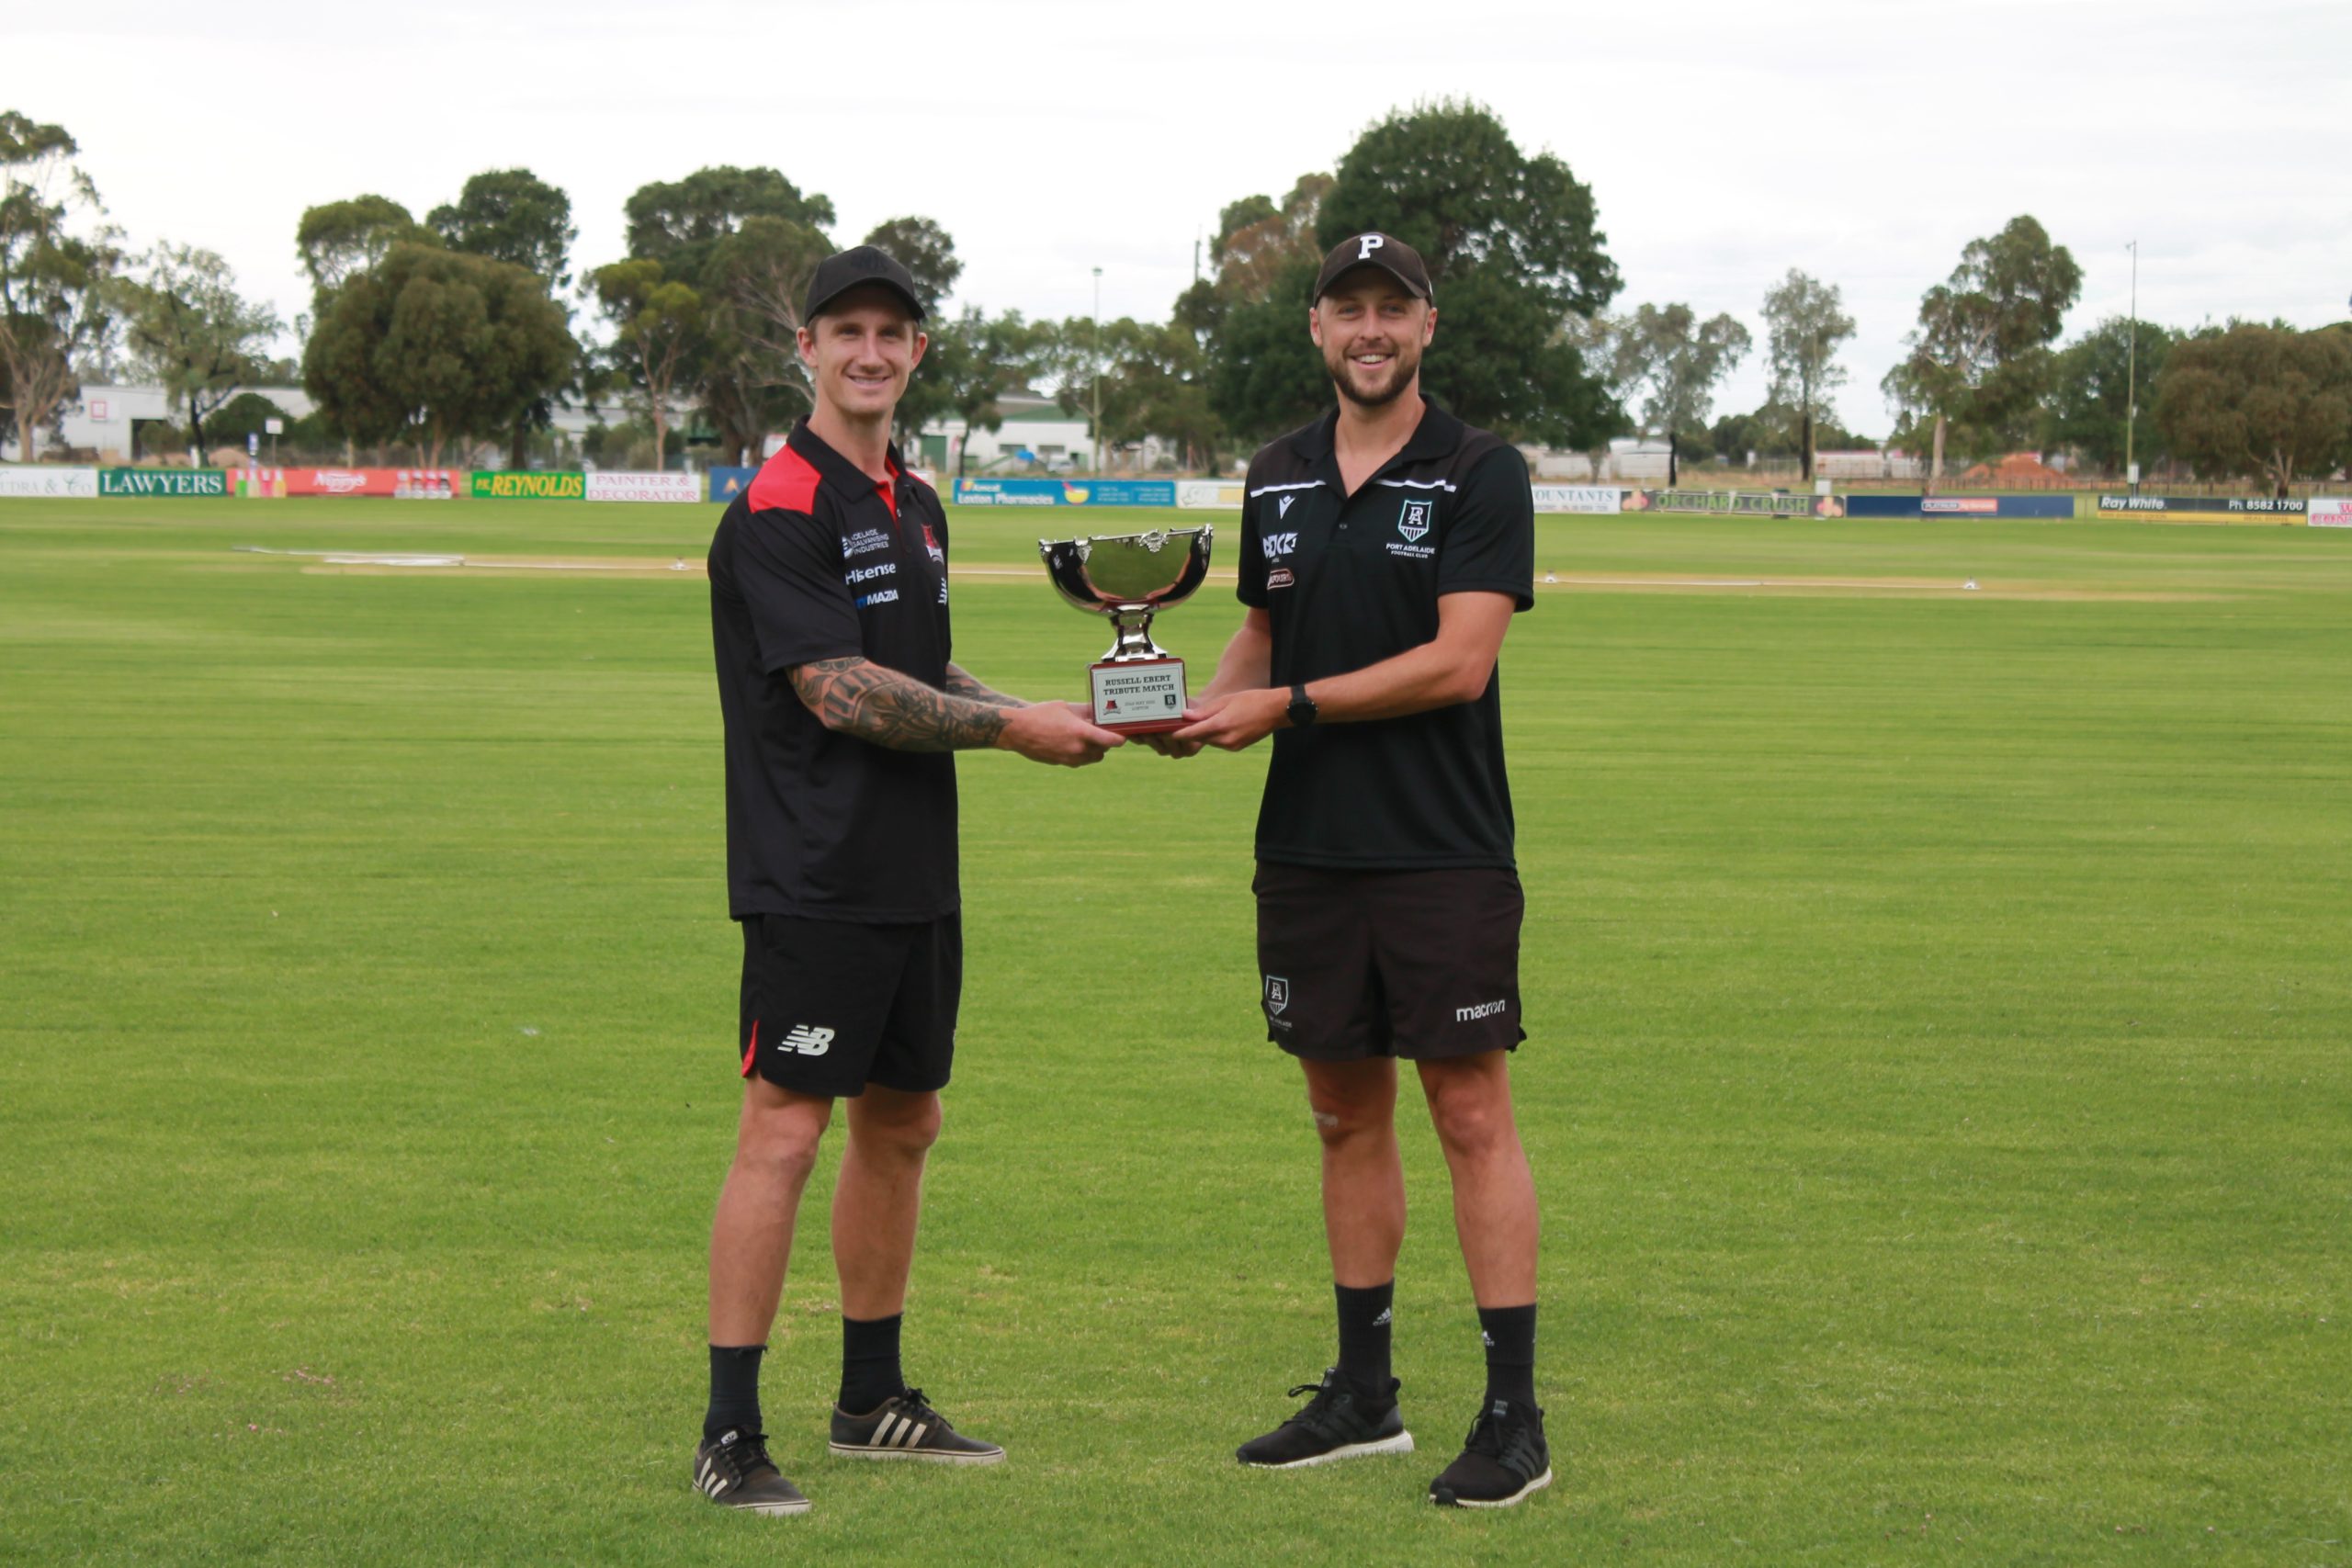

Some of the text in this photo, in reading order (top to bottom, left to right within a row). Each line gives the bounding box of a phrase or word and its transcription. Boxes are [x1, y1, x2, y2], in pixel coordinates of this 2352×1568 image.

[1359, 235, 1384, 259] P
[104, 473, 222, 494] LAWYERS
[491, 474, 584, 497] REYNOLDS
[595, 476, 690, 487] PAINTER &
[588, 490, 698, 502] DECORATOR
[1532, 489, 1614, 502] OUNTANTS
[1657, 493, 1809, 513] ORCHARD CRUSH
[2101, 496, 2128, 511] Ray
[2246, 501, 2274, 511] 8582
[2277, 501, 2303, 511] 1700
[1385, 543, 1435, 555] PORT ADELAIDE
[845, 563, 897, 585] Hisense
[1105, 674, 1171, 687] RUSSELL EBERT
[1103, 683, 1174, 696] TRIBUTE MATCH
[1455, 999, 1506, 1022] macron
